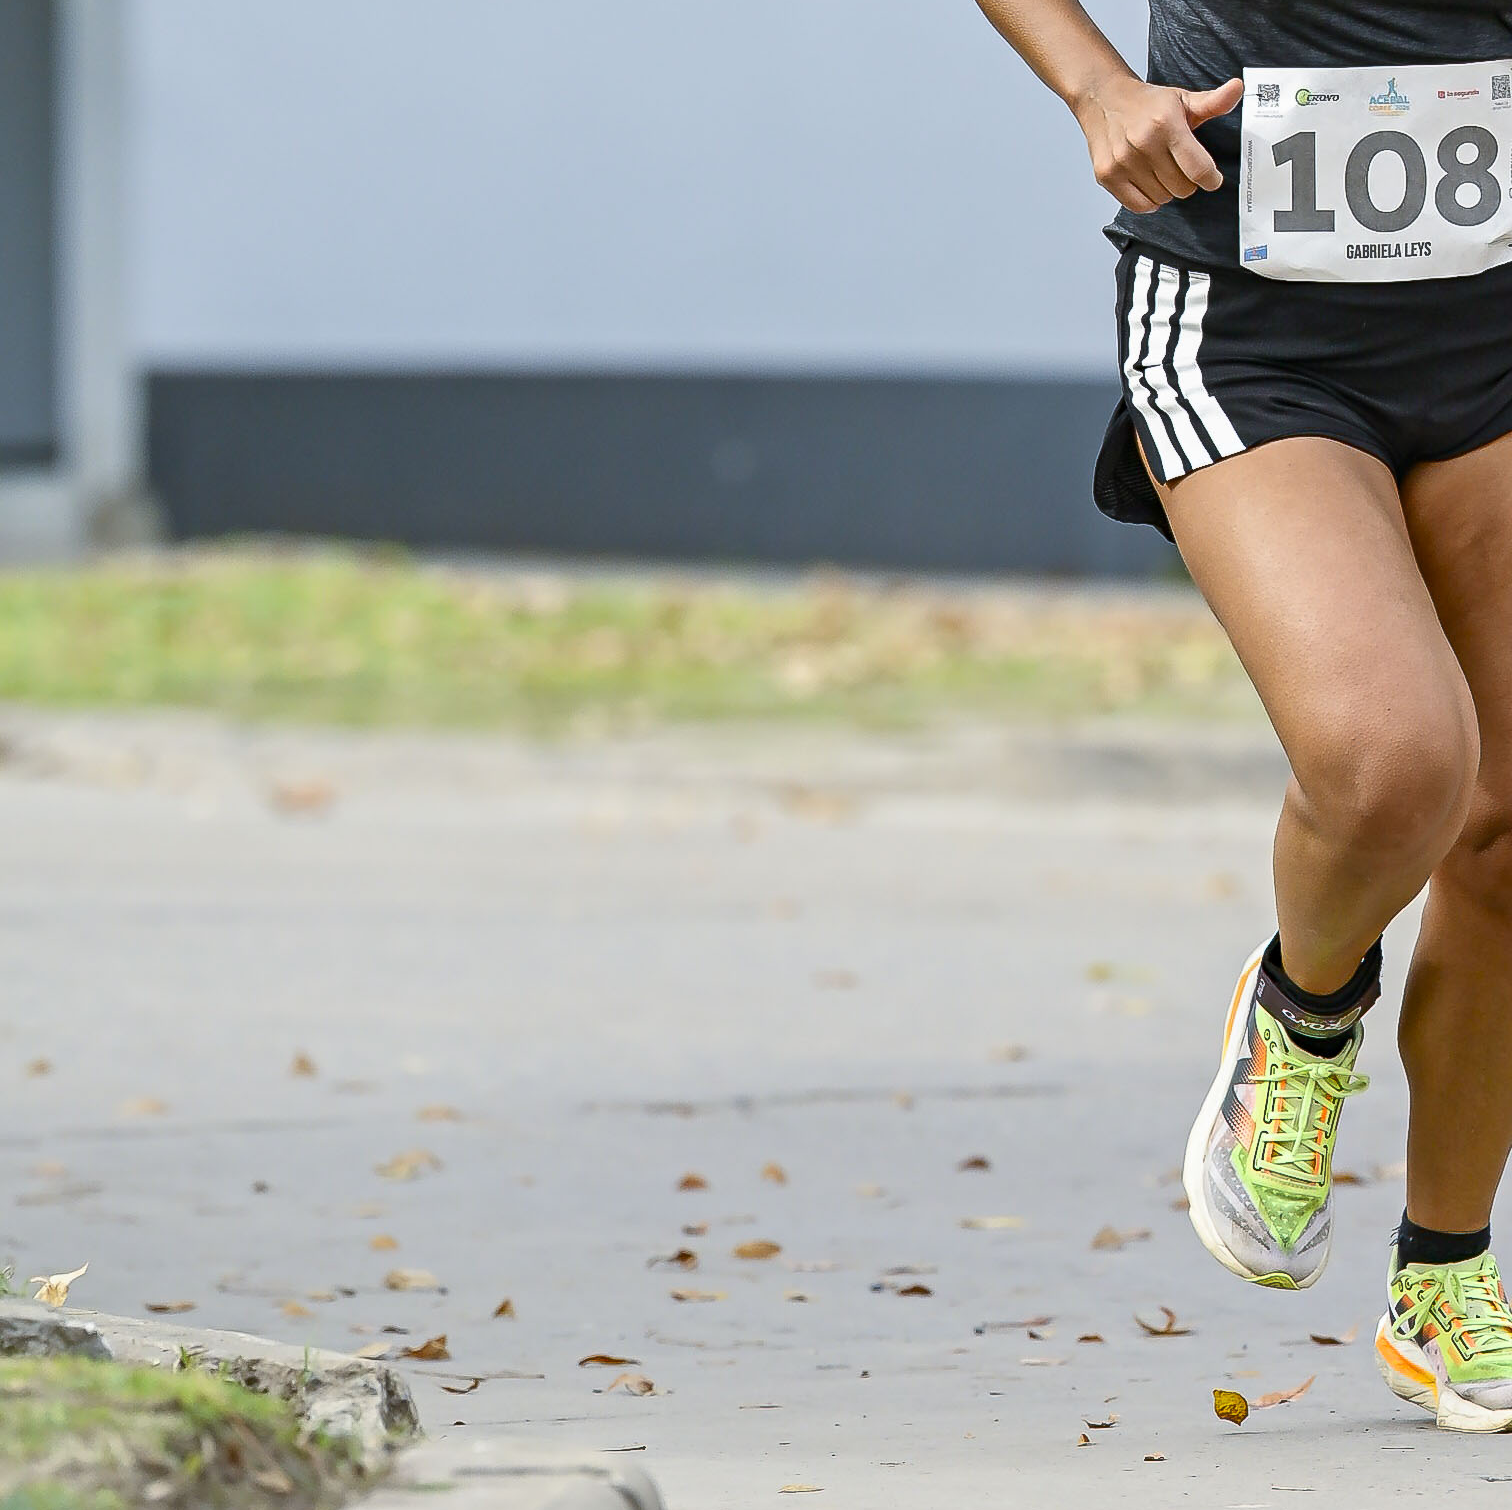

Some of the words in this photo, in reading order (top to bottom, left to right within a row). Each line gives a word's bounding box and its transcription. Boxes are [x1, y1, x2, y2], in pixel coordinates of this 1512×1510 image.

[1271, 125, 1502, 233] 108
[1346, 243, 1402, 259] GABRIELA
[1404, 241, 1432, 258] LEYS
